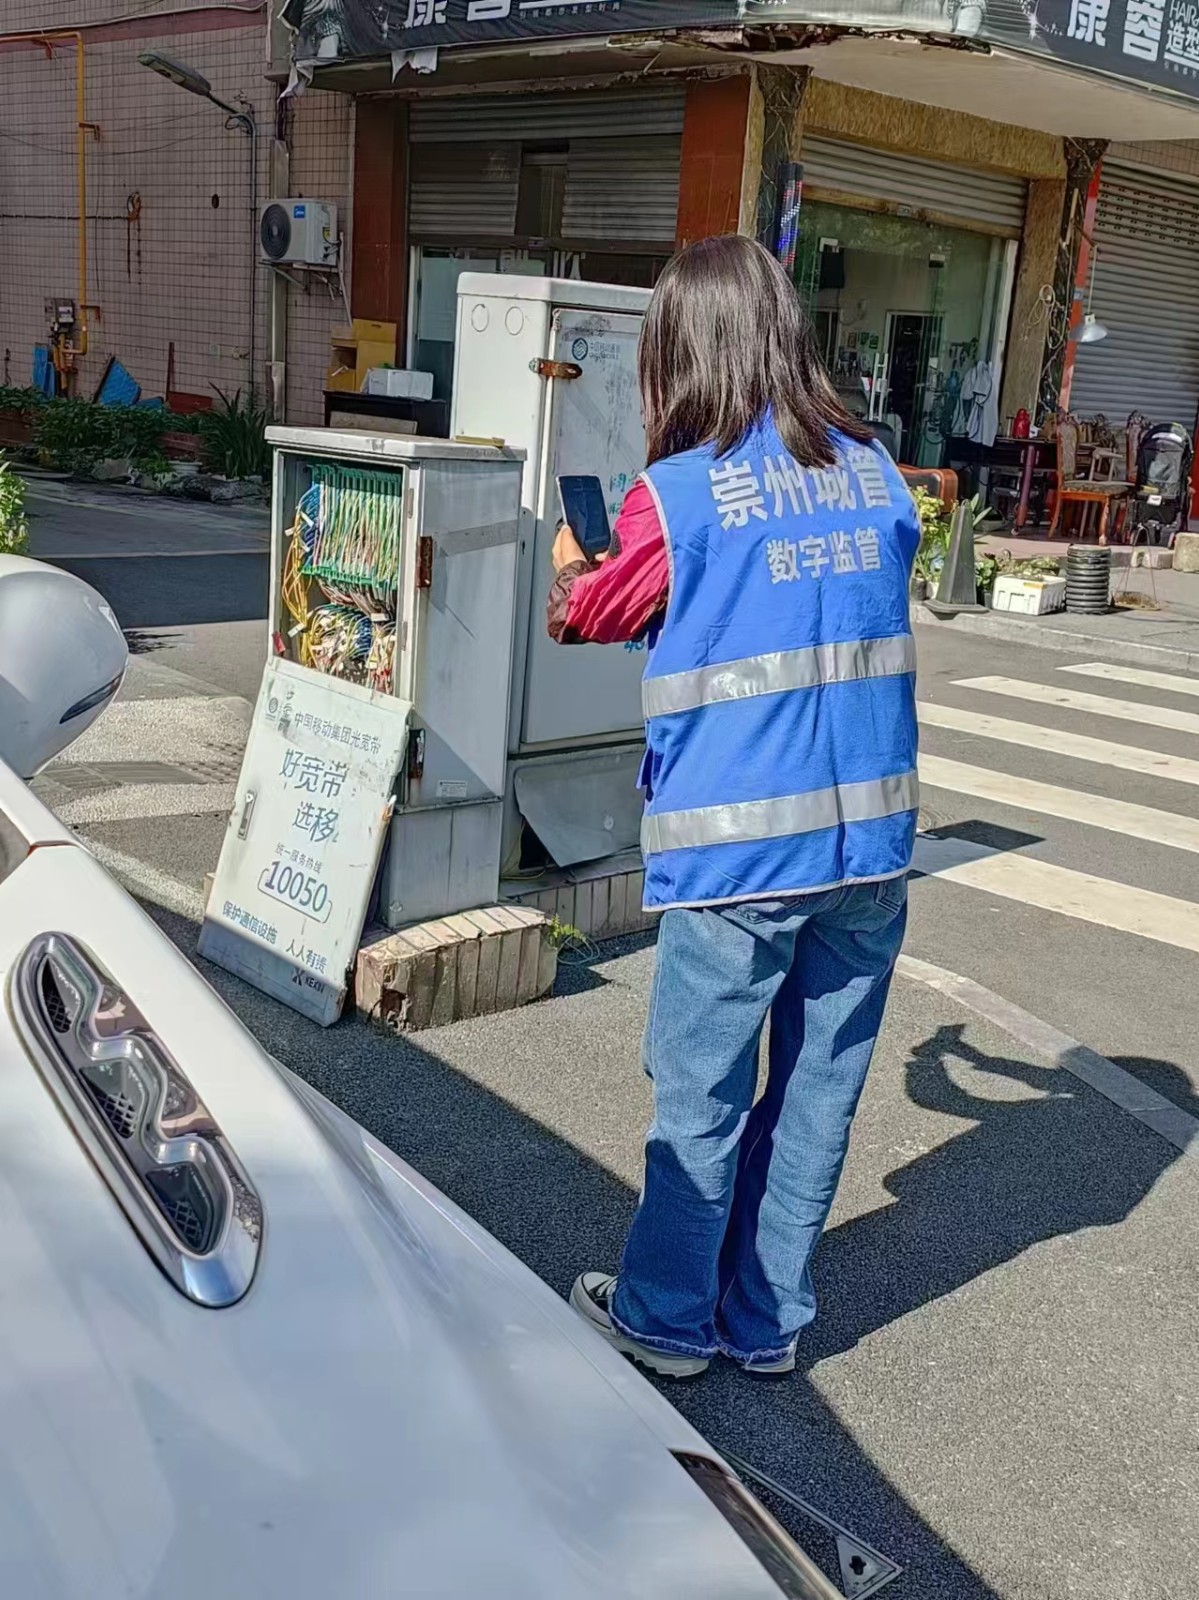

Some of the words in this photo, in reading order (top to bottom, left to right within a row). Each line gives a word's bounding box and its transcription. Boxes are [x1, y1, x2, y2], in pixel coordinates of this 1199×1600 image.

[709, 445, 893, 532] 崇州城管
[766, 526, 881, 585] 数字监管
[279, 748, 350, 798] 好宽带
[292, 800, 340, 843] 选移
[275, 842, 323, 874] 统一服务热线
[264, 860, 329, 912] 10050
[222, 900, 279, 945] 保护通信设施
[285, 938, 328, 975] 人人有责
